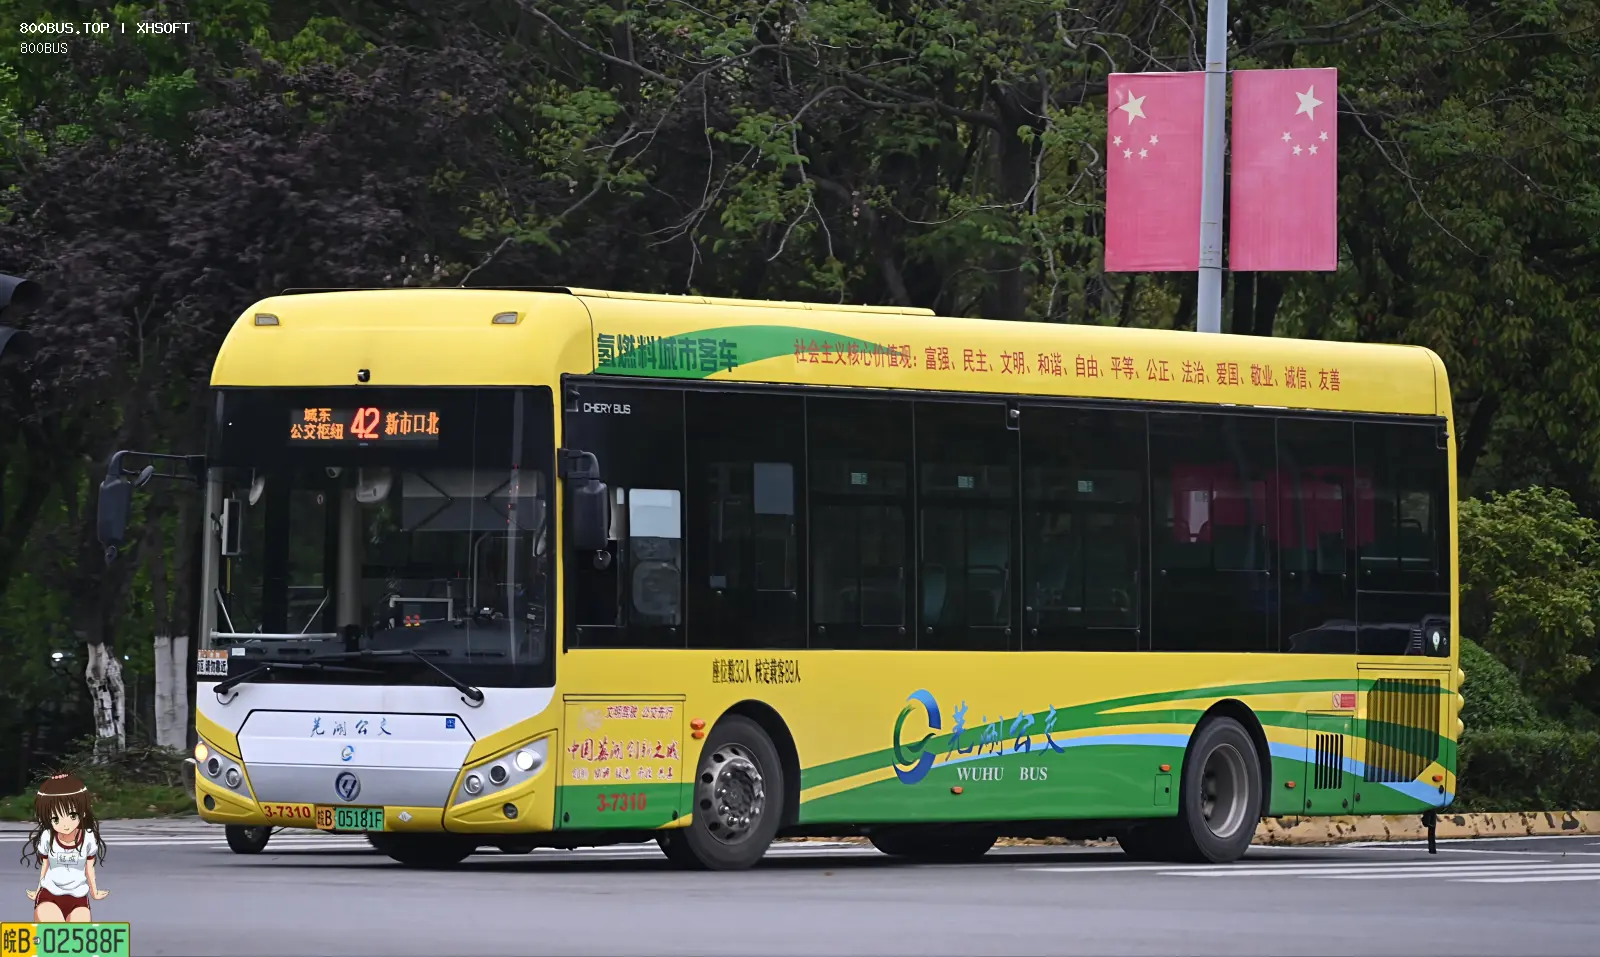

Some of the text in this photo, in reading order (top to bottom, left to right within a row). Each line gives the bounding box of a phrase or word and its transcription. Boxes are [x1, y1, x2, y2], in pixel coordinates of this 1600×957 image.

[596, 332, 739, 373] 氢燃料城市客车
[303, 407, 332, 422] 城东
[583, 402, 632, 415] CHERY BUS
[290, 423, 344, 440] 公交枢纽
[350, 407, 380, 439] 42
[384, 410, 440, 436] 新市口北
[957, 766, 1048, 781] WUHU BUS
[597, 792, 647, 812] 3-7310
[263, 805, 311, 818] 3-7310
